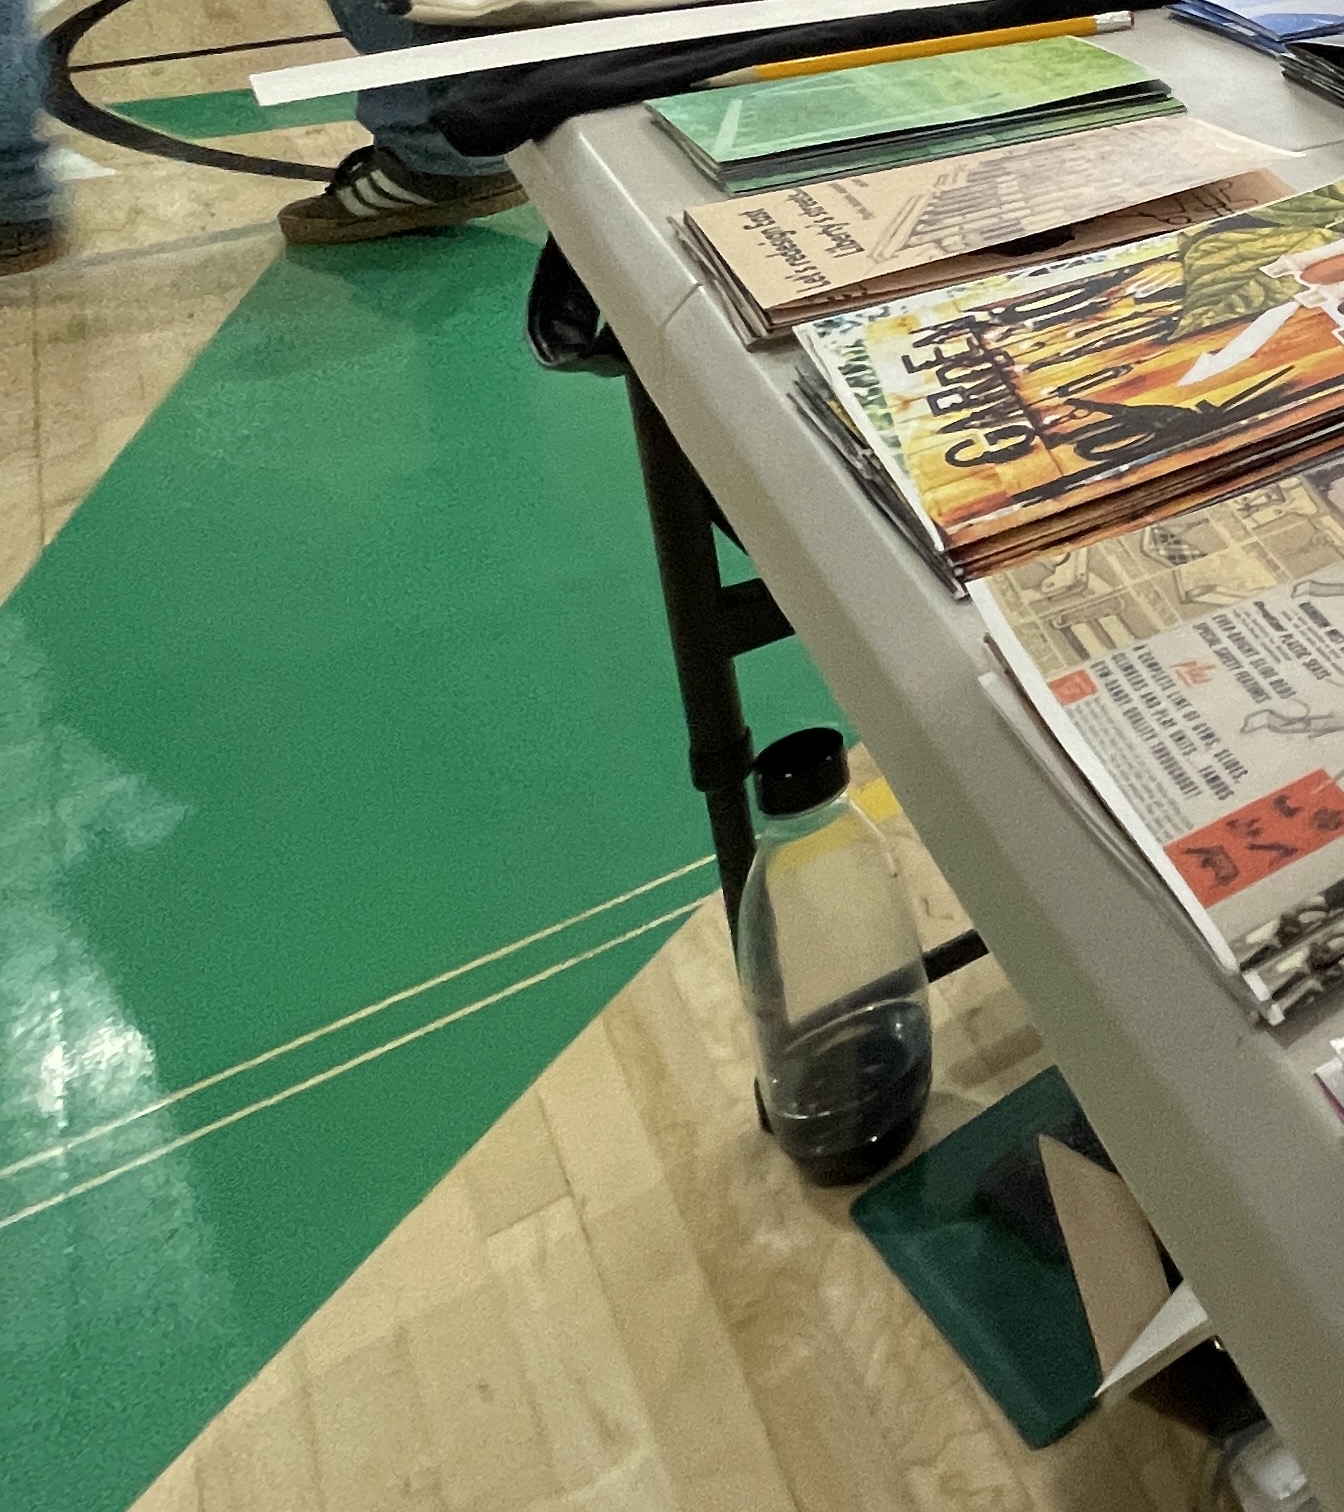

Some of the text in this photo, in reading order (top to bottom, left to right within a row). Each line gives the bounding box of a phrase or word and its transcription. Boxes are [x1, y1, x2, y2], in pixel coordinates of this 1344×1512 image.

[737, 208, 831, 294] Let's redesign East
[803, 217, 865, 259] Liberty's
[901, 315, 1038, 468] GARDEN
[1137, 651, 1177, 692] COMPLETE
[1166, 690, 1193, 712] LINE
[1151, 708, 1178, 731] PLAY
[1197, 764, 1236, 802] FAMOUS
